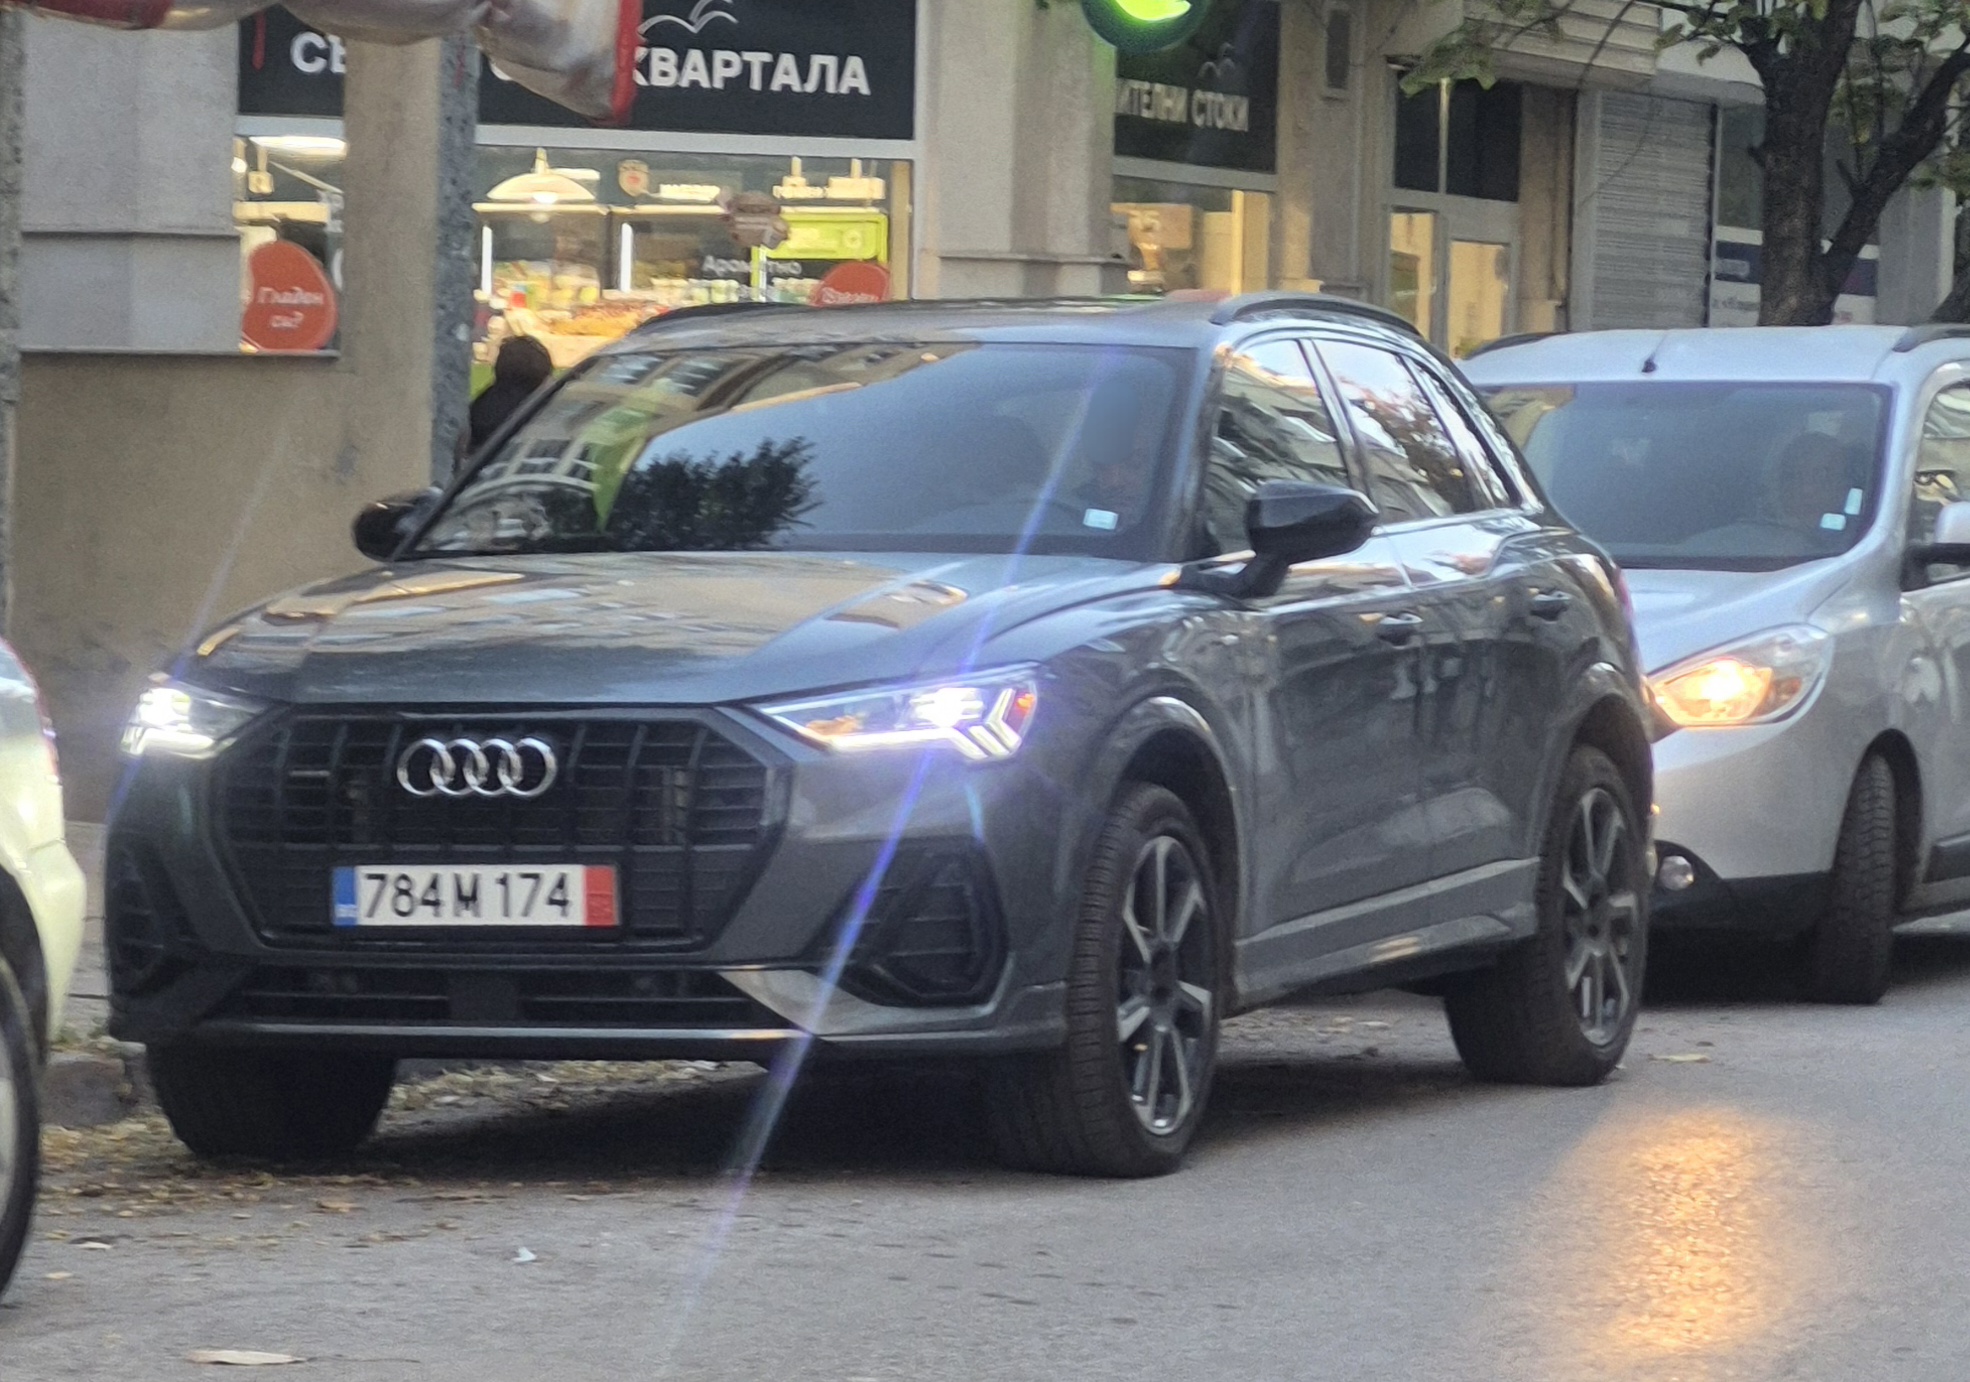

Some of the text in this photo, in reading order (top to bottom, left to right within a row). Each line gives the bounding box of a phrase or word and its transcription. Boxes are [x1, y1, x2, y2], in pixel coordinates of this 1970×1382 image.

[364, 873, 441, 918] 784
[453, 873, 481, 917] M
[495, 873, 571, 917] 174
